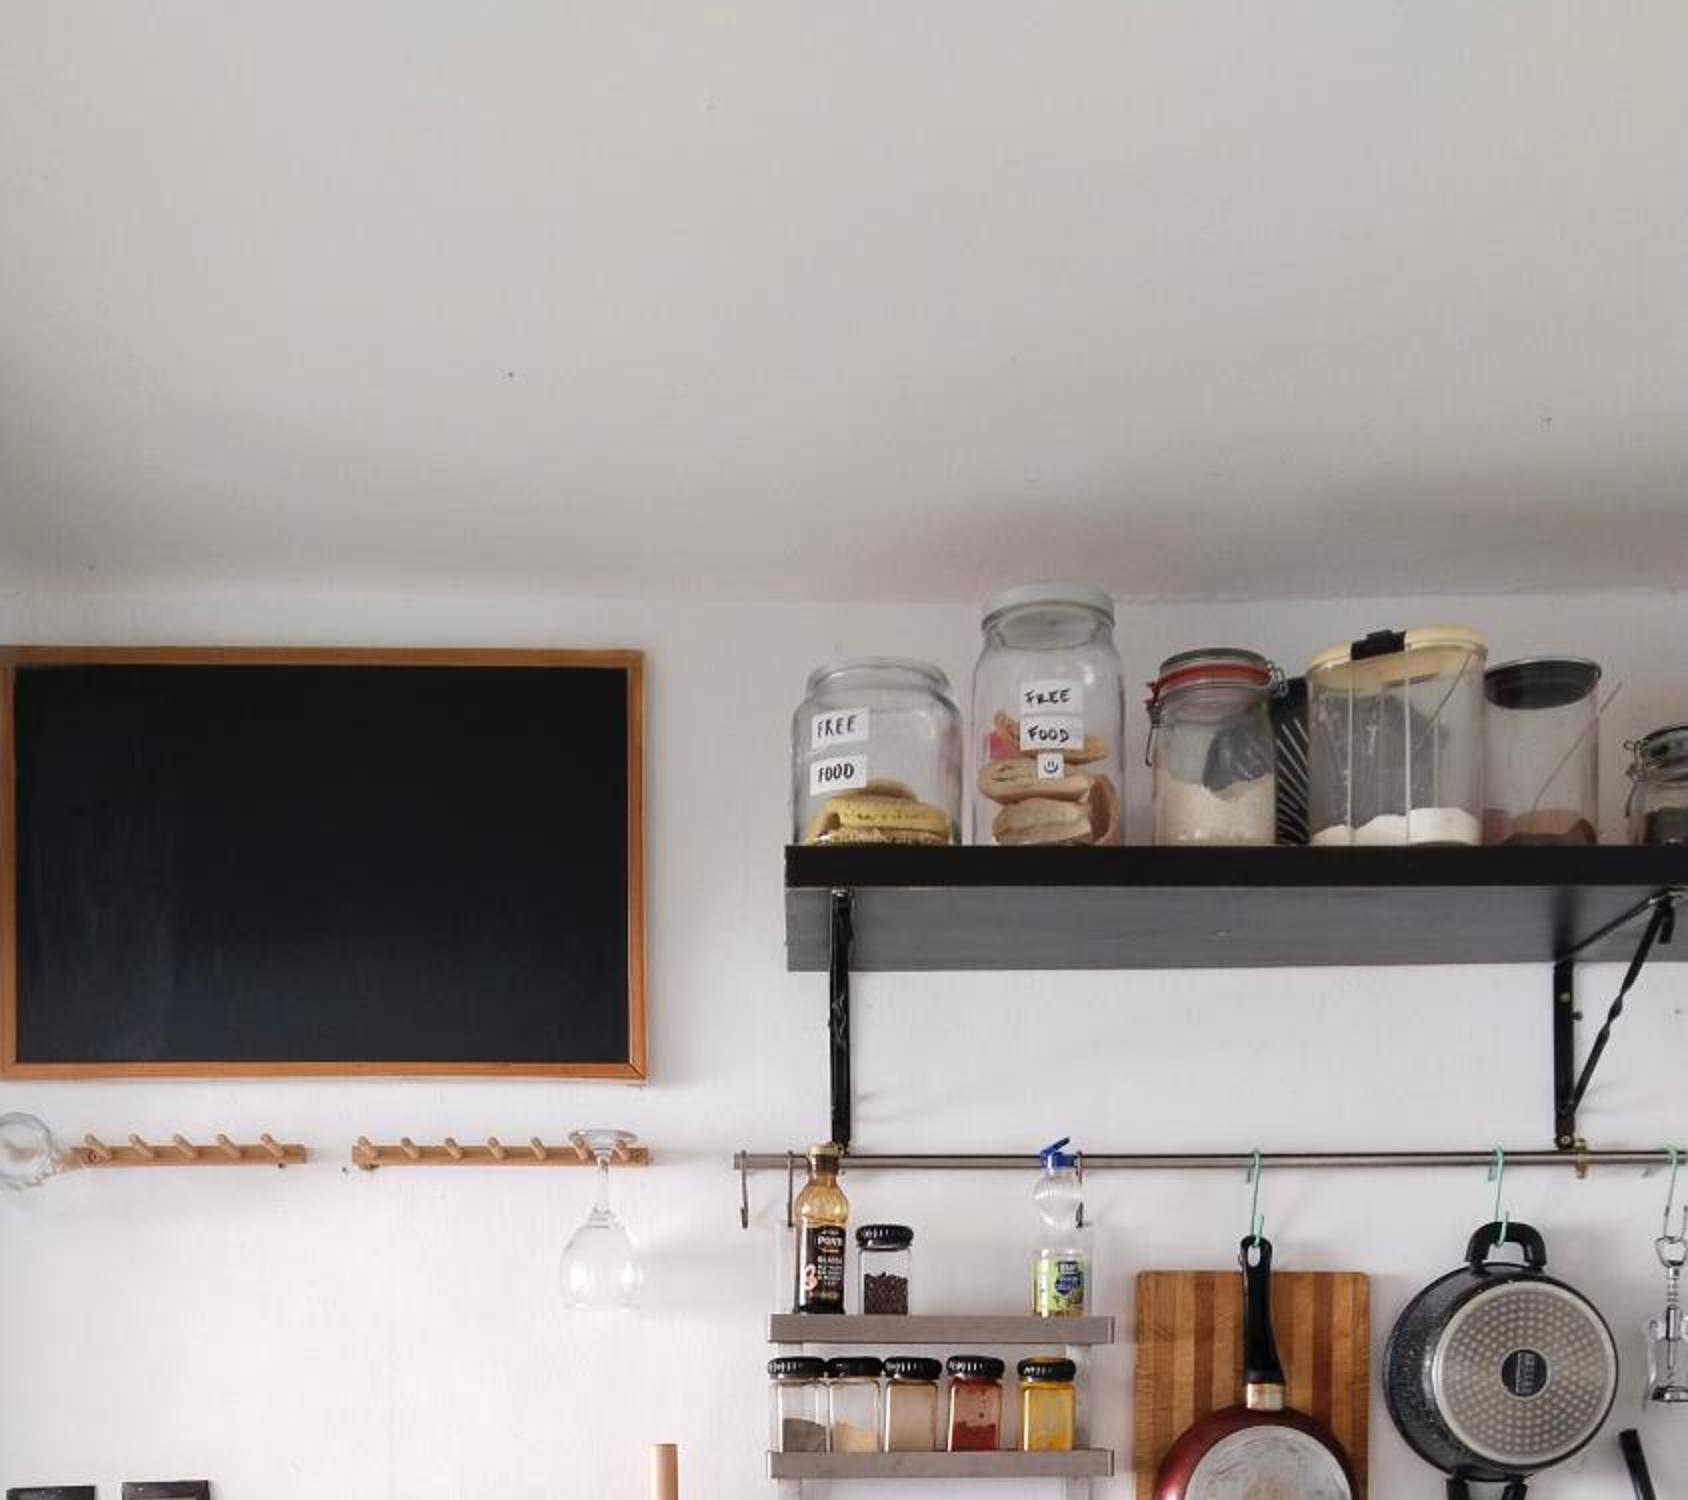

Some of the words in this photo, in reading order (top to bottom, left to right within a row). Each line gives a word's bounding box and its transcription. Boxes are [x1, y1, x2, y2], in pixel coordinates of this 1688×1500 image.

[1024, 688, 1072, 705] FREE
[817, 715, 858, 738] FREE
[1028, 725, 1069, 742] FOOD
[817, 763, 855, 783] FOOD
